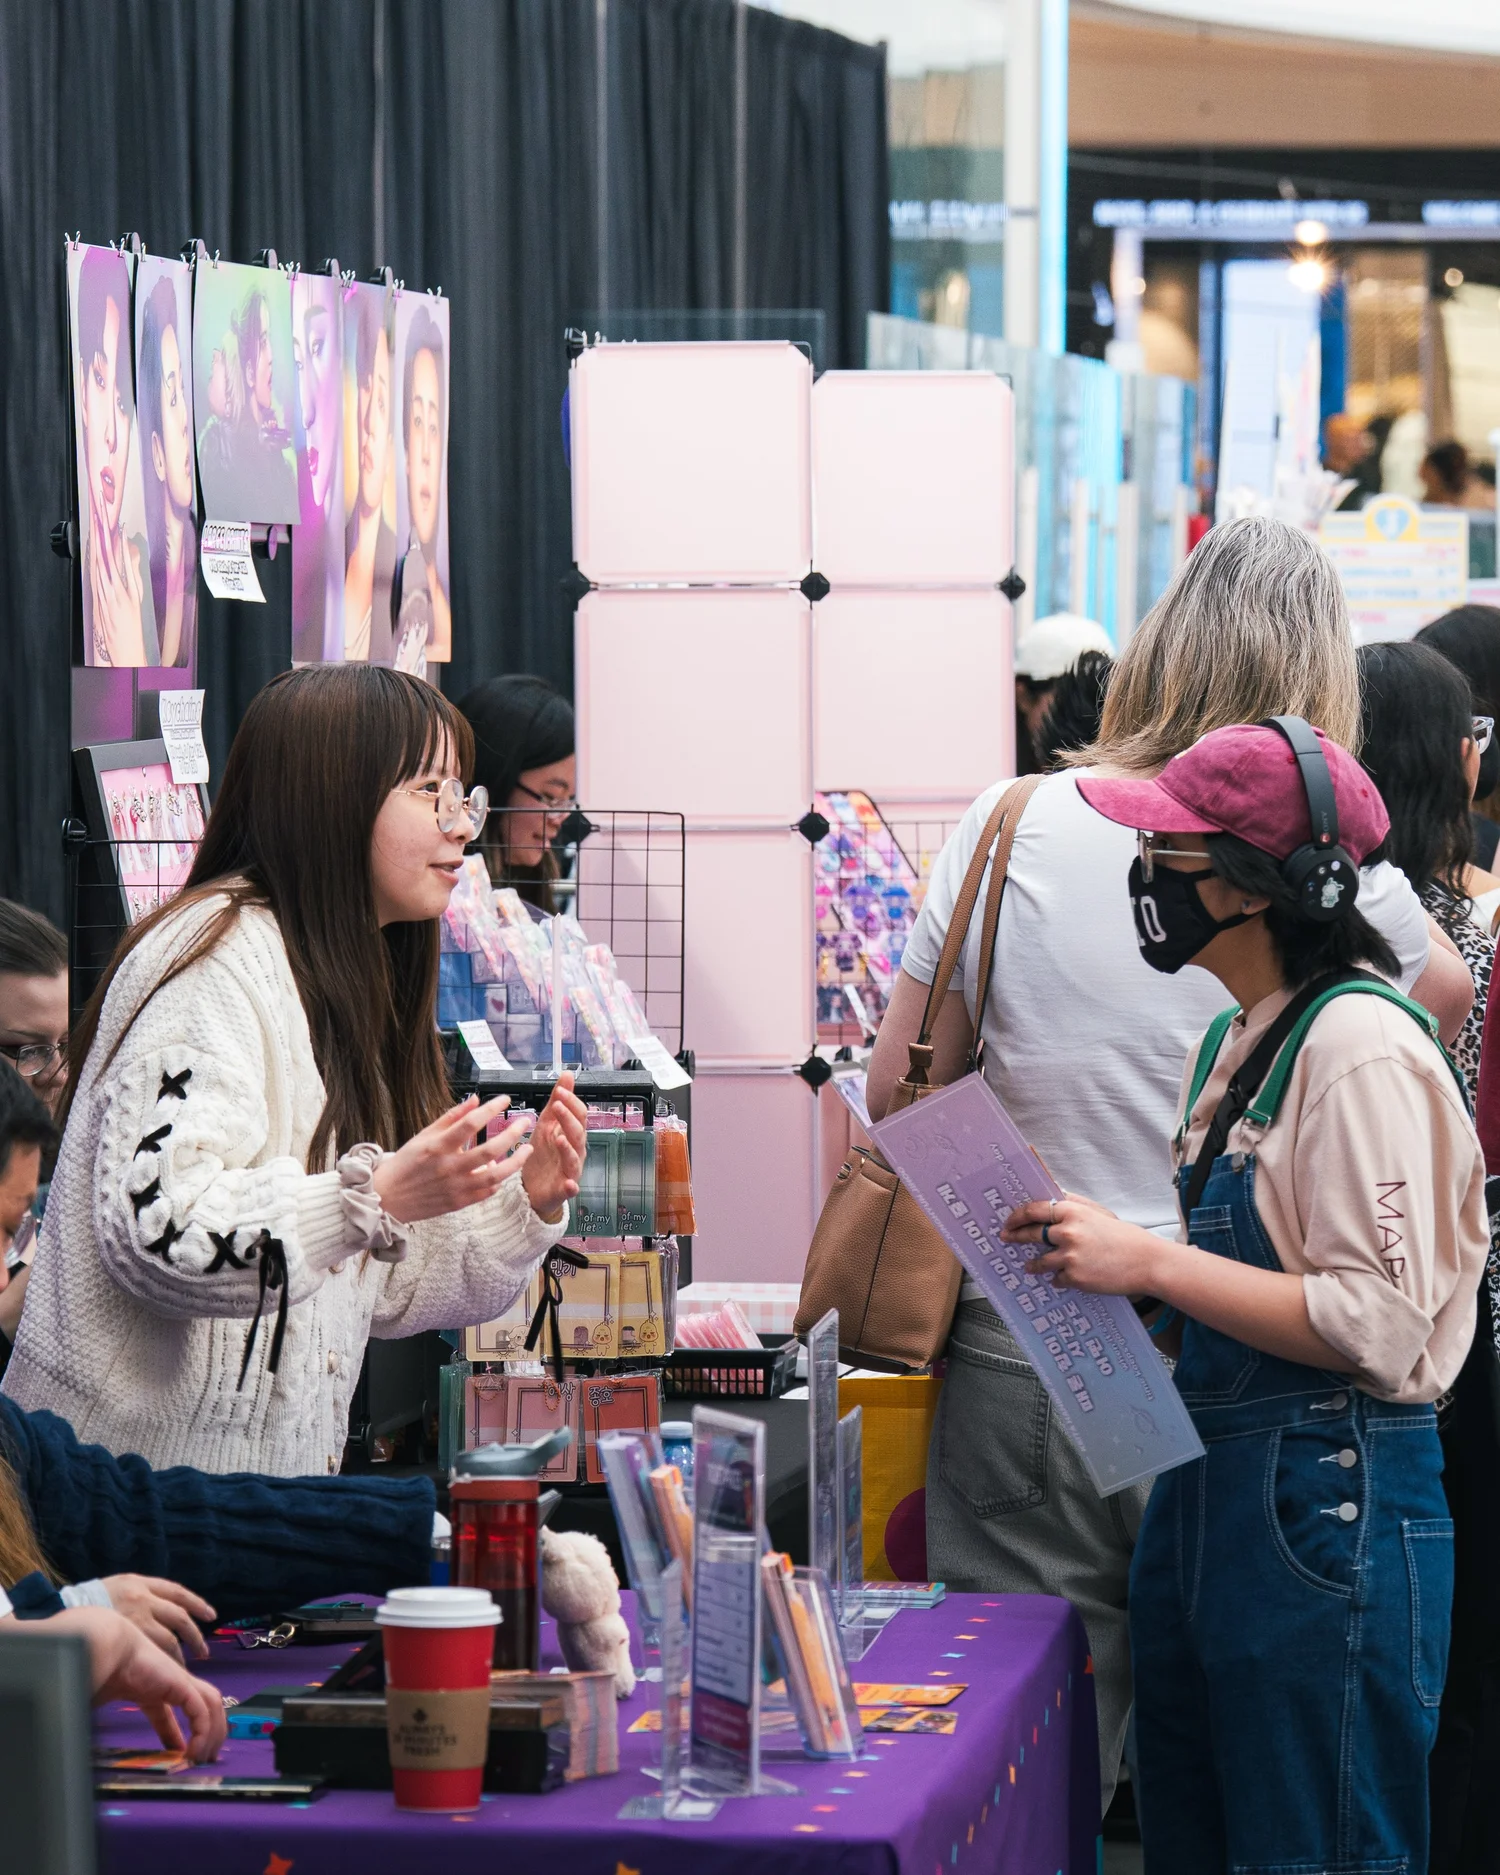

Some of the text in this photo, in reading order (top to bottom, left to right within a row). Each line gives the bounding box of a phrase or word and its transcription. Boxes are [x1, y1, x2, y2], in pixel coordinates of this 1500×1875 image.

[988, 1141, 1004, 1160] day
[1001, 1177, 1017, 1196] you
[584, 1213, 611, 1224] of my
[621, 1212, 647, 1223] of my
[961, 1219, 994, 1256] 되어
[1046, 1307, 1085, 1359] 시간은
[589, 1386, 615, 1407] 종호
